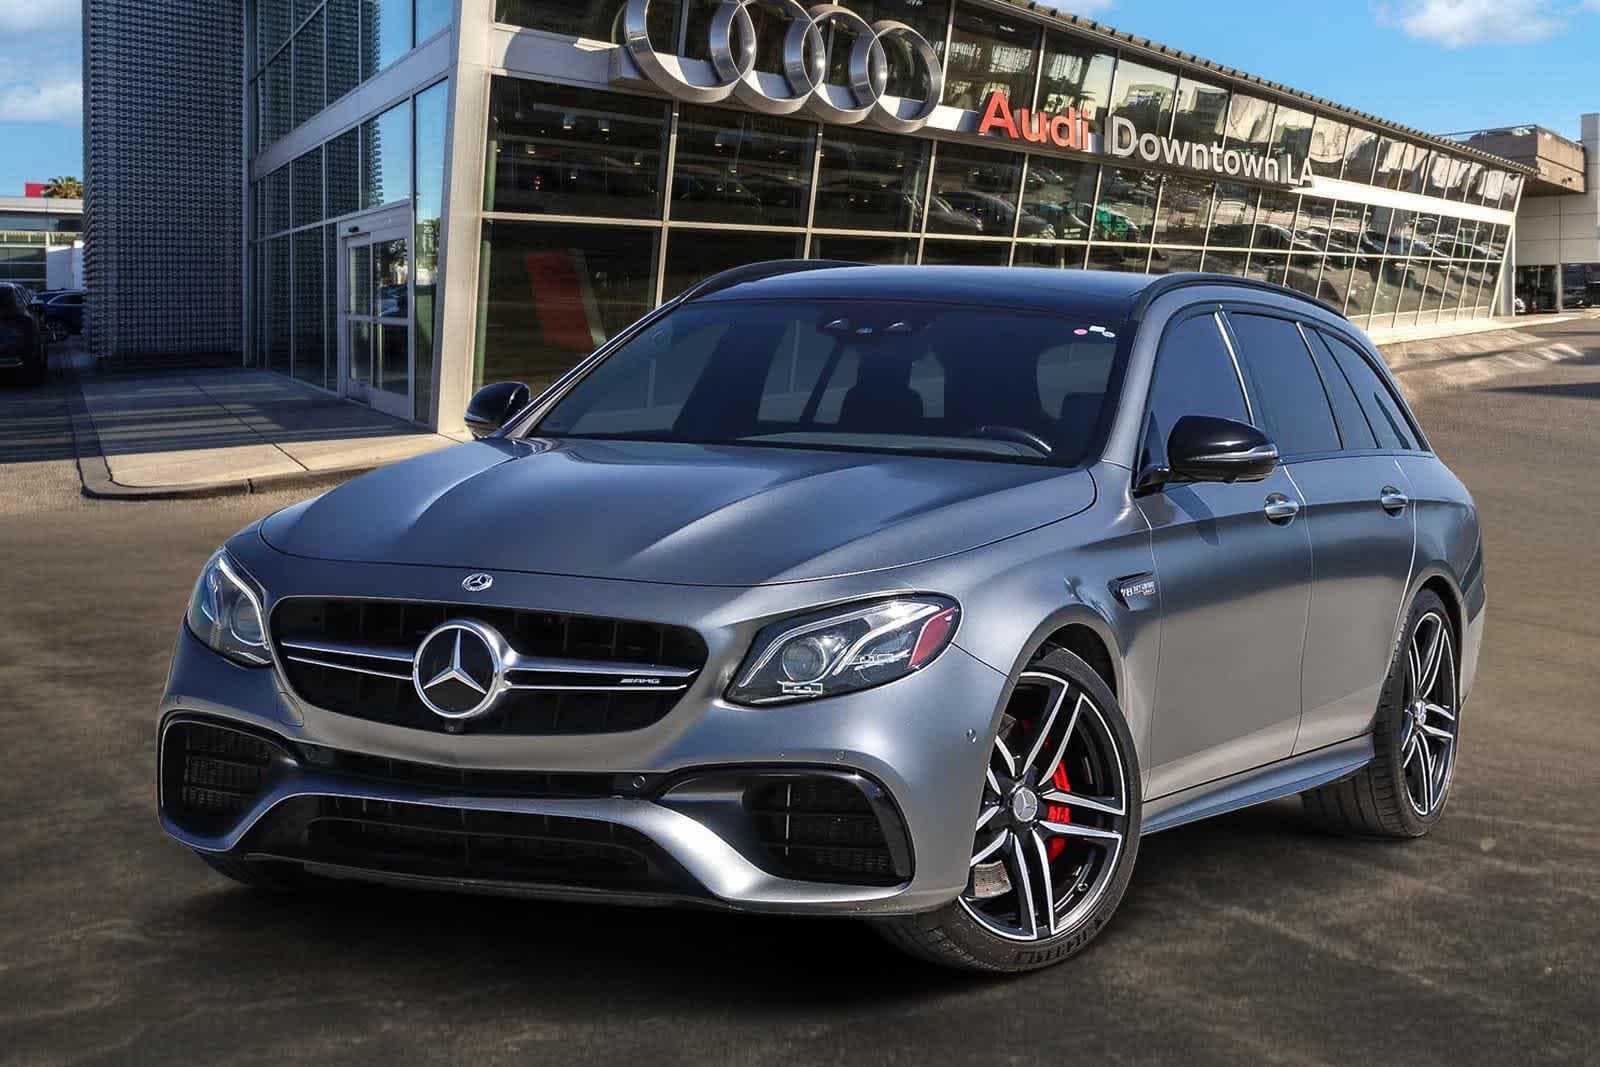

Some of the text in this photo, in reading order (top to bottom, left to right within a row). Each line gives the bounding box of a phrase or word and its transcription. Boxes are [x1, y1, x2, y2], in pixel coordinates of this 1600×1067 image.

[977, 90, 1315, 188] Audi Downtown LA
